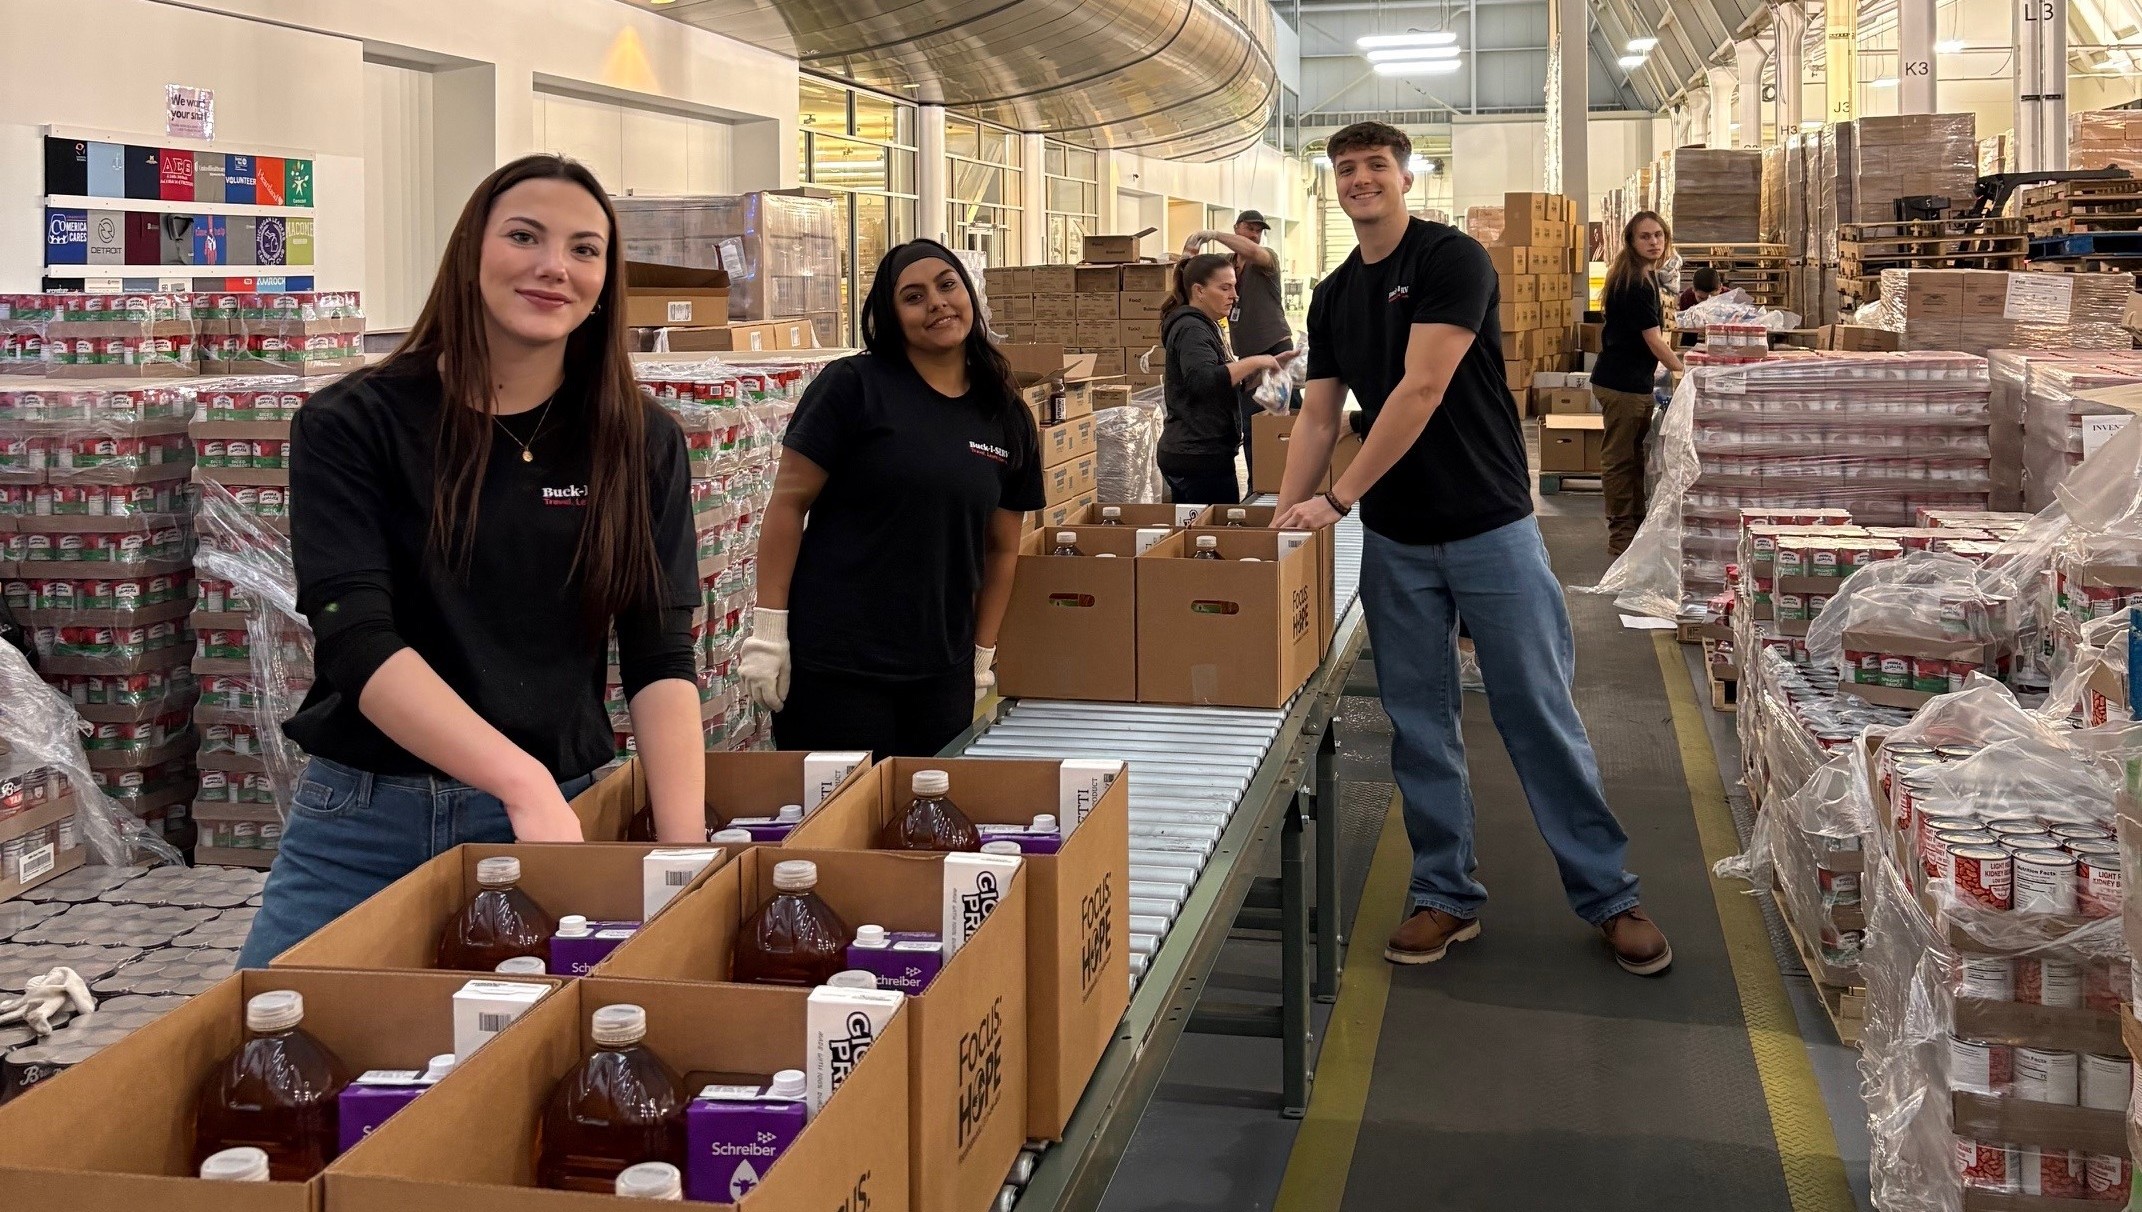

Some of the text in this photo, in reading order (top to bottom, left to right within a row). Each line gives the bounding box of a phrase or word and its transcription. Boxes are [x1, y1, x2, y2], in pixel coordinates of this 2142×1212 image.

[2025, 3, 2054, 21] L3
[1905, 61, 1929, 76] K3
[171, 94, 186, 106] We
[1833, 101, 1850, 113] J3
[171, 110, 190, 121] your
[1780, 125, 1798, 135] H3
[225, 176, 257, 186] VOLUNTEER
[69, 232, 87, 242] CARES
[90, 246, 122, 255] DETROIT
[1990, 862, 2004, 870] LIGHT
[2016, 865, 2038, 875] Nutrition
[1984, 870, 2004, 878] KIDNEY
[2098, 871, 2116, 880] LIGHT
[1082, 904, 1111, 991] HOPE
[875, 975, 922, 988] chreiber
[958, 1035, 1002, 1150] HOPE
[711, 1141, 776, 1157] Schreiber
